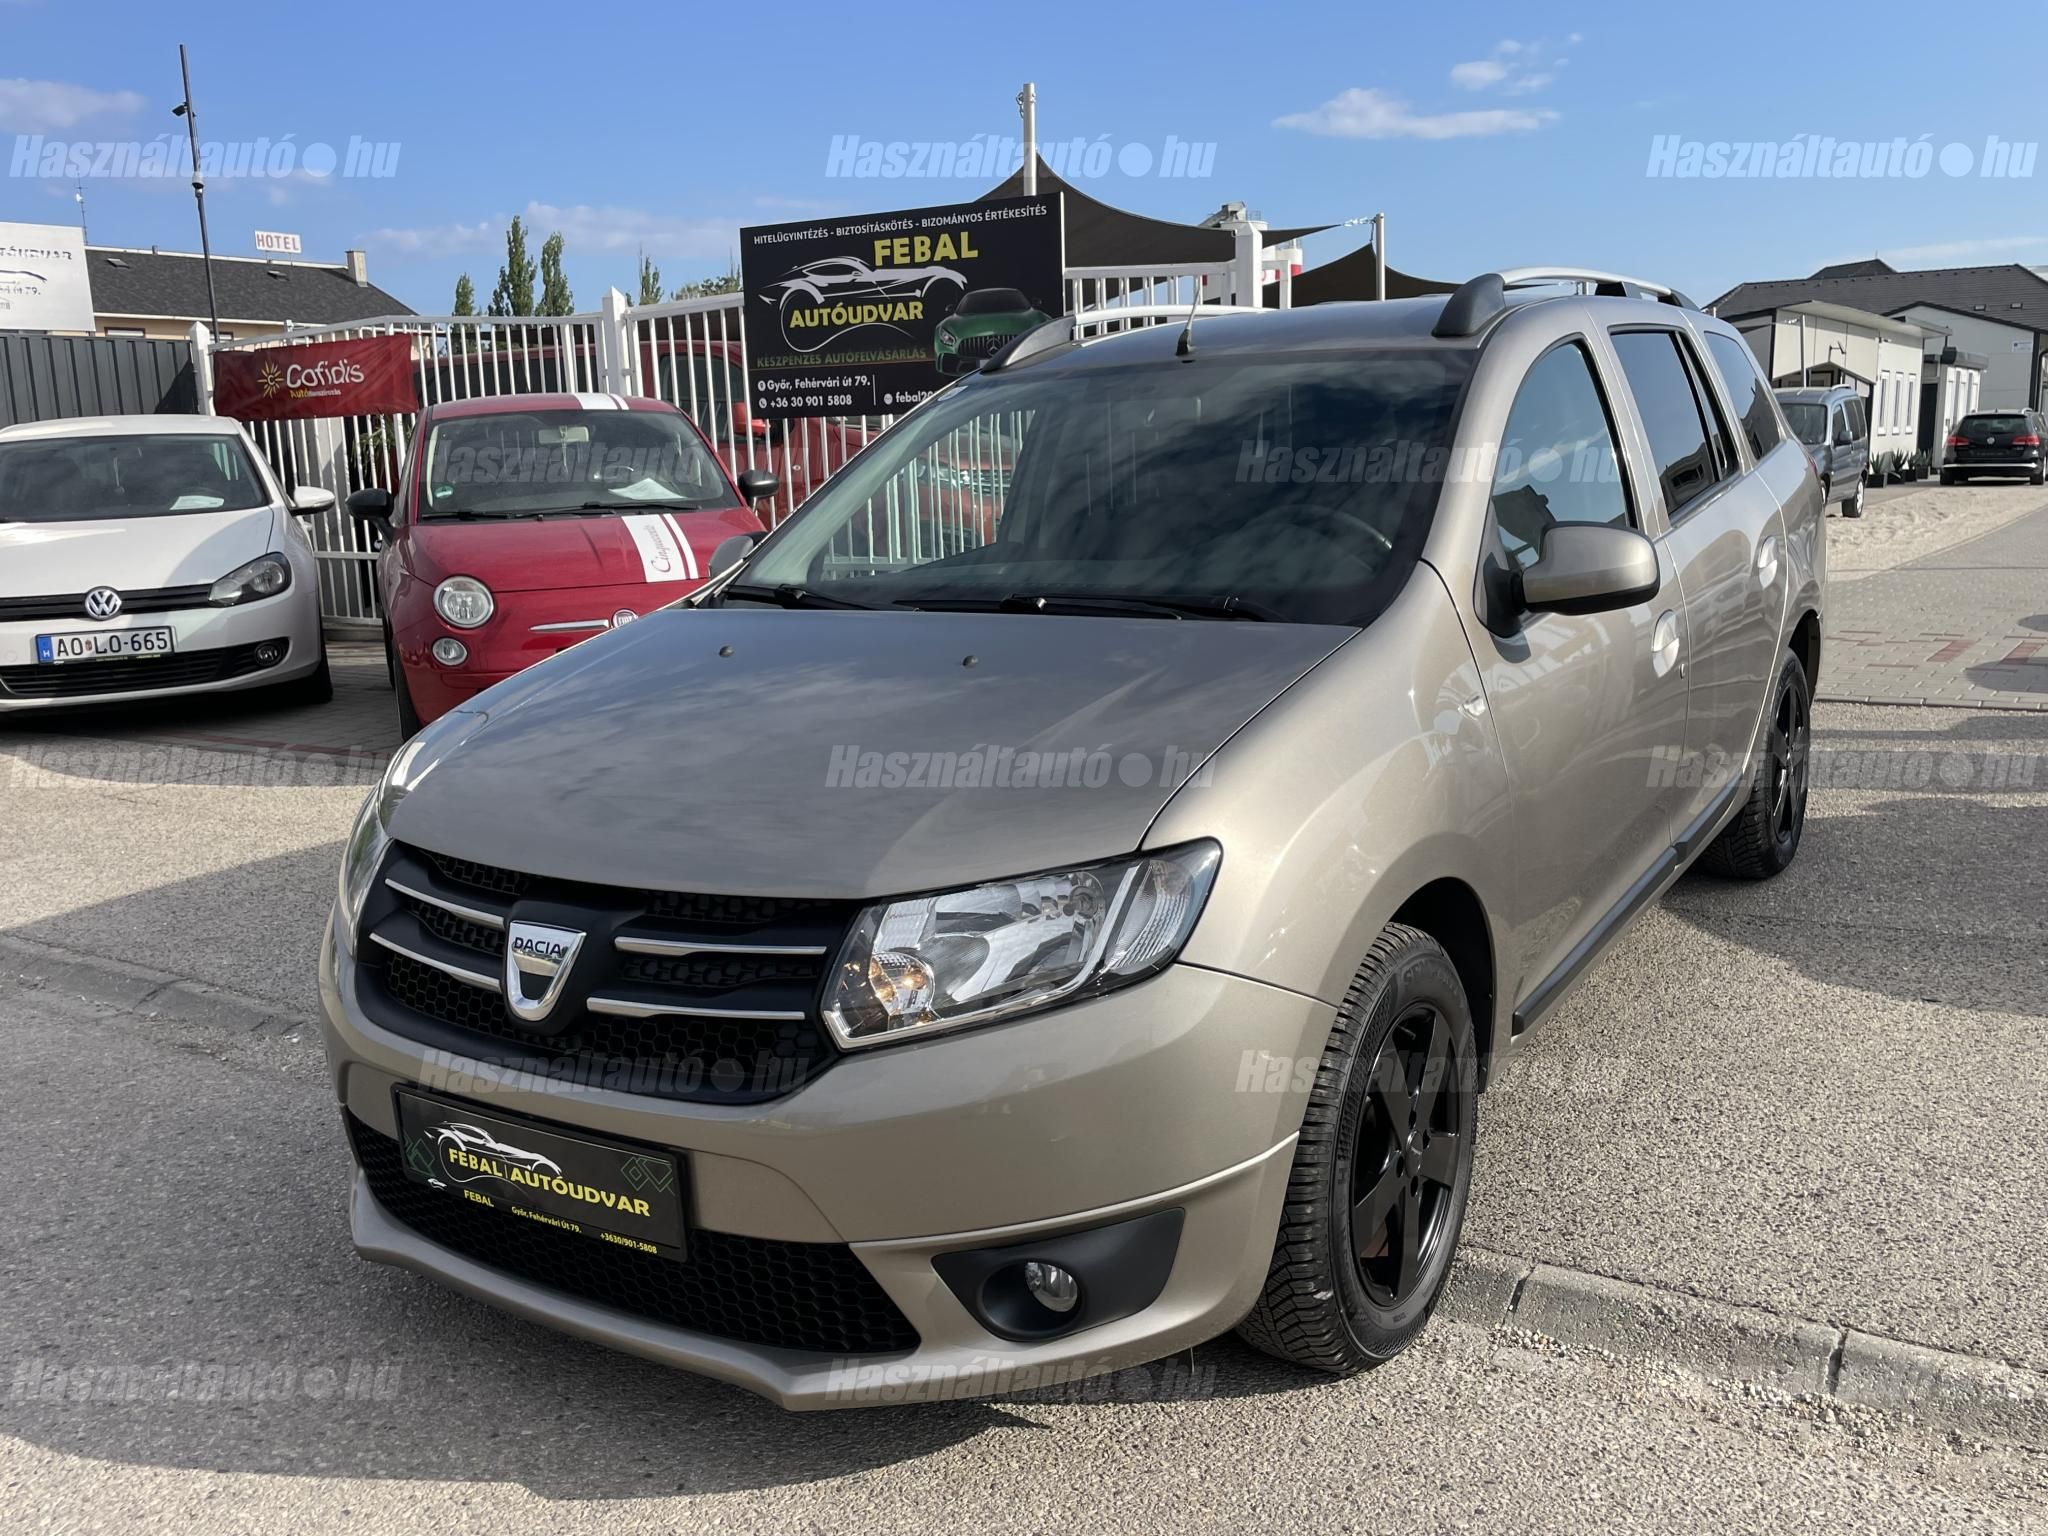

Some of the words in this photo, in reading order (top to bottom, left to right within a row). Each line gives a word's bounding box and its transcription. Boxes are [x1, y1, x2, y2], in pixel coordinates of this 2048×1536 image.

[753, 227, 828, 245] HITELÜGYINTÉZÉS
[836, 218, 914, 236] BIZTOSÍTÁSKÖTÉS
[921, 212, 983, 228] BIZOMÁNYOS
[984, 204, 1047, 221] ÉRTÉKESÍTÉS
[256, 233, 299, 251] HOTEL
[874, 231, 978, 266] FEBAL
[789, 301, 924, 329] AUTÓUDVAR
[286, 358, 365, 388] Cofidis
[767, 379, 793, 393] Győr,
[795, 376, 840, 389] Fehérvári
[854, 375, 871, 387] 79.
[770, 396, 788, 408] +36
[790, 396, 803, 407] 30
[805, 395, 823, 407] 901
[827, 394, 852, 406] 5808
[513, 937, 561, 955] DACIA
[448, 1147, 503, 1178] FEBAL
[510, 1166, 651, 1217] AUTÓUDVAR
[463, 1189, 495, 1208] FEBAL
[600, 1232, 658, 1255] +3630/901-5808
